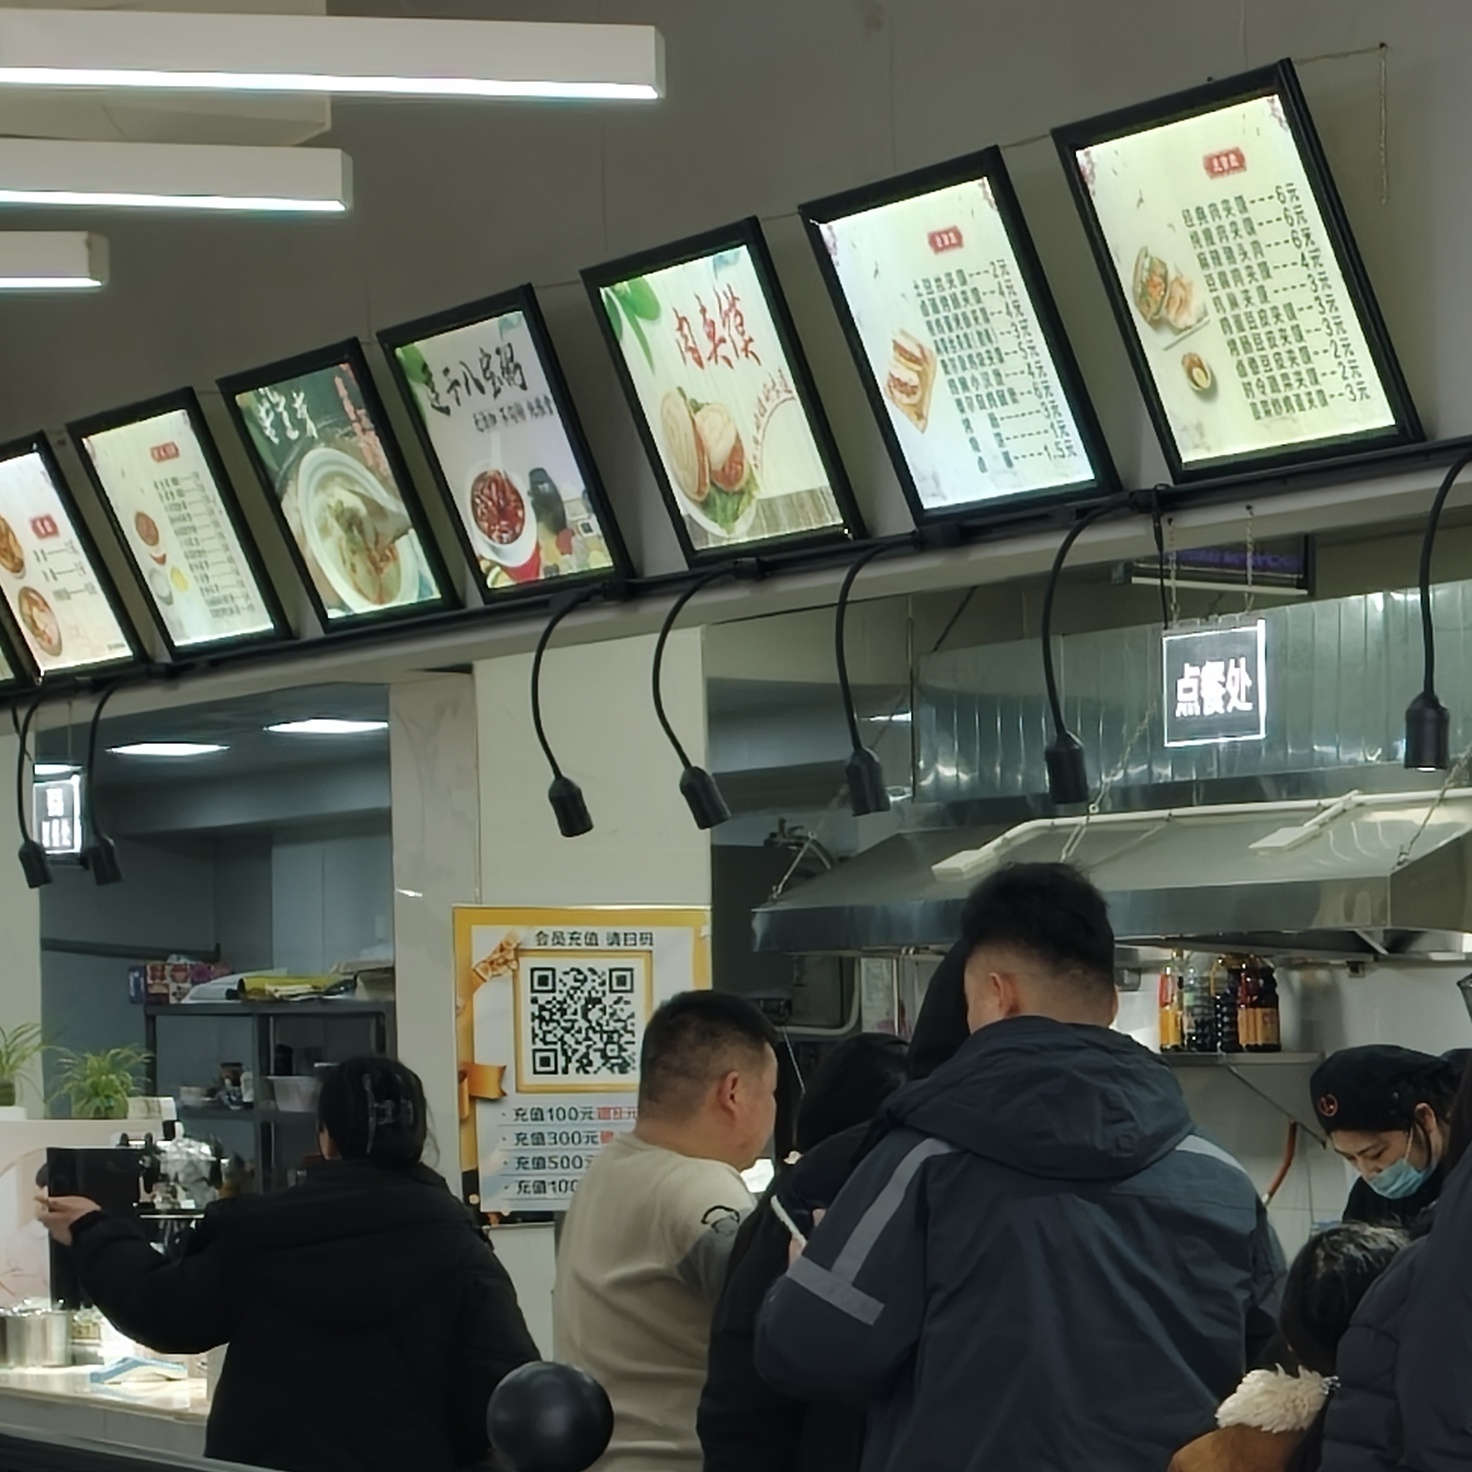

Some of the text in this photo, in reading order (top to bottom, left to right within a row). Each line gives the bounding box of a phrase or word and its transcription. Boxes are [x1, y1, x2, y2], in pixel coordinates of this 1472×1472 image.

[1175, 657, 1253, 717] 点餐处
[535, 930, 599, 947] 会员充值
